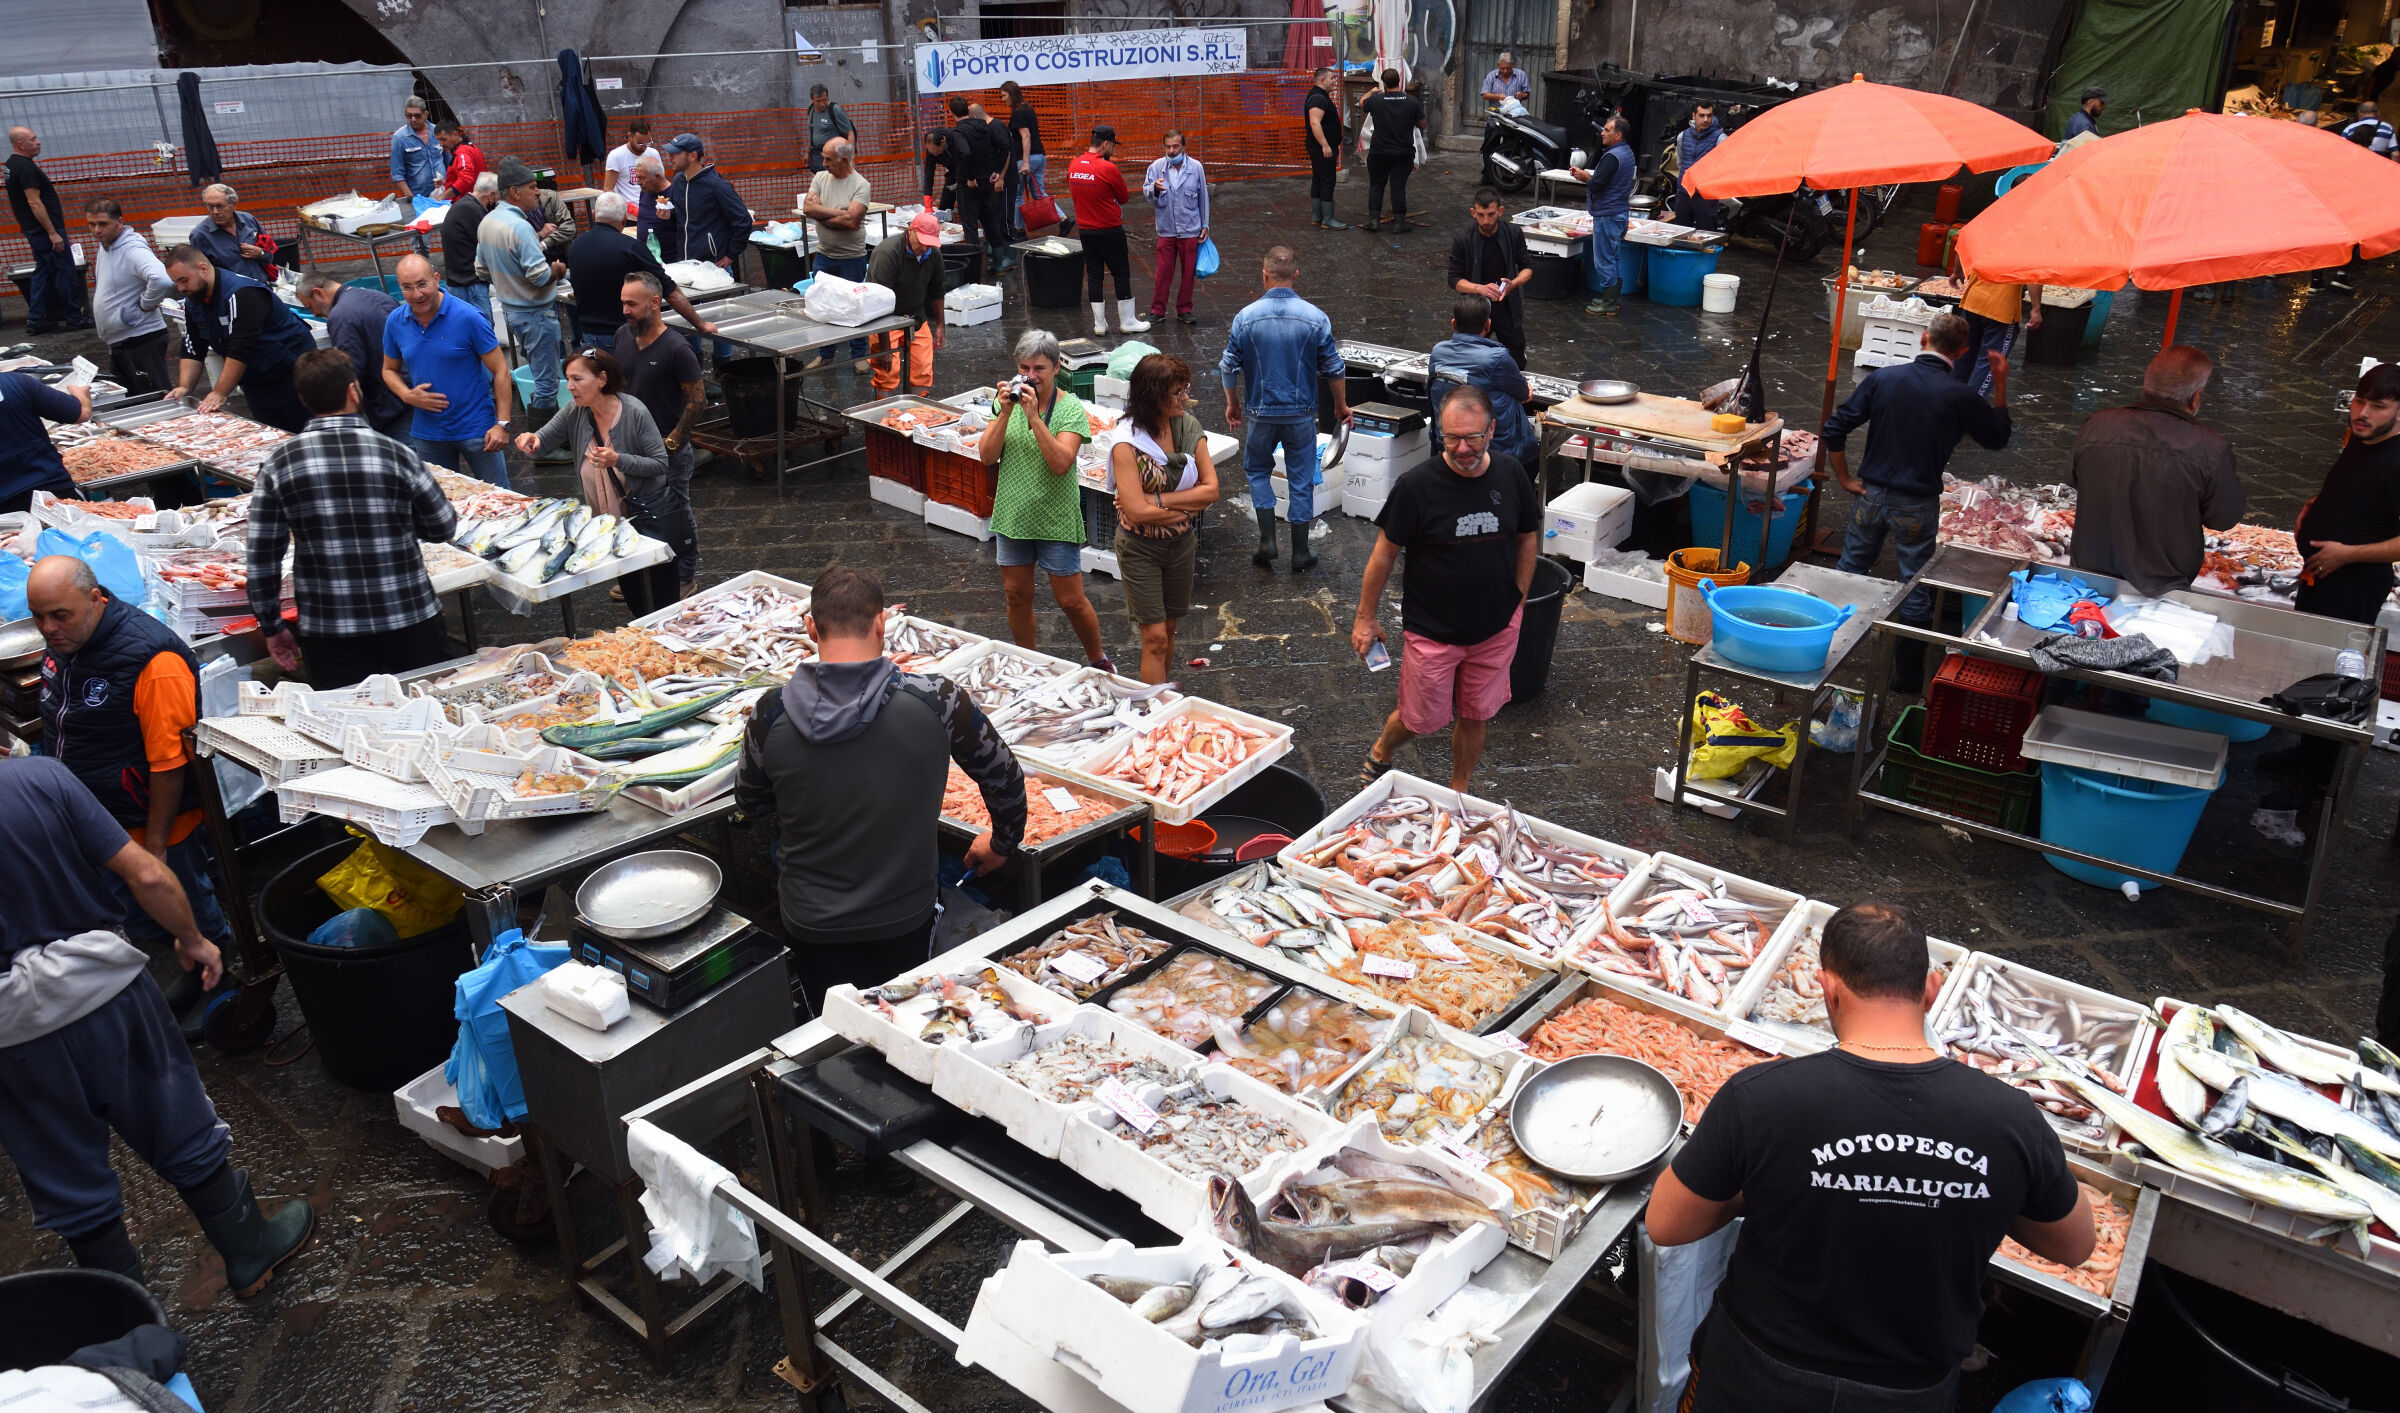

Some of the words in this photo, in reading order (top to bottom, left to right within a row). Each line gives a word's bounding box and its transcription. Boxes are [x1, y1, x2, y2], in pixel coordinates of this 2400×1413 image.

[952, 53, 1029, 76] PORTO
[1035, 45, 1181, 71] COSTRUZIONI
[1186, 43, 1241, 61] S.R.L.
[1070, 172, 1095, 180] LEGEA
[1811, 1133, 1988, 1176] MOTOPESCA
[1810, 1171, 1991, 1199] MARIALUCIA
[1224, 1368, 1279, 1398] Ora.
[1290, 1350, 1336, 1385] Gel
